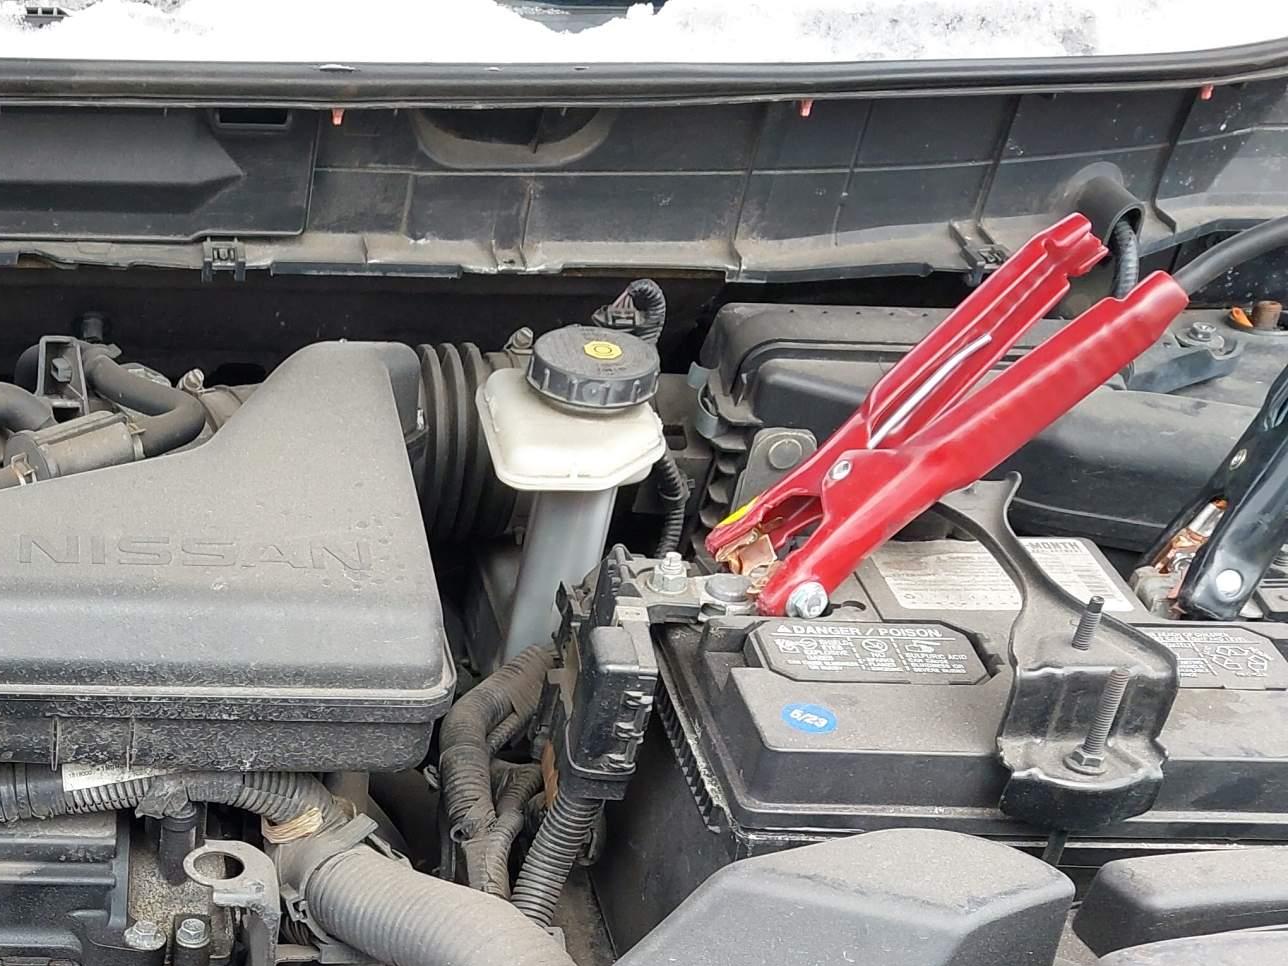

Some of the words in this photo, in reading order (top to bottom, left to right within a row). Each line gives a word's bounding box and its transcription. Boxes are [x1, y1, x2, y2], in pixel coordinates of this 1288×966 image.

[19, 534, 373, 571] NISSAN
[792, 625, 861, 636] DANGER
[878, 628, 942, 637] POISON
